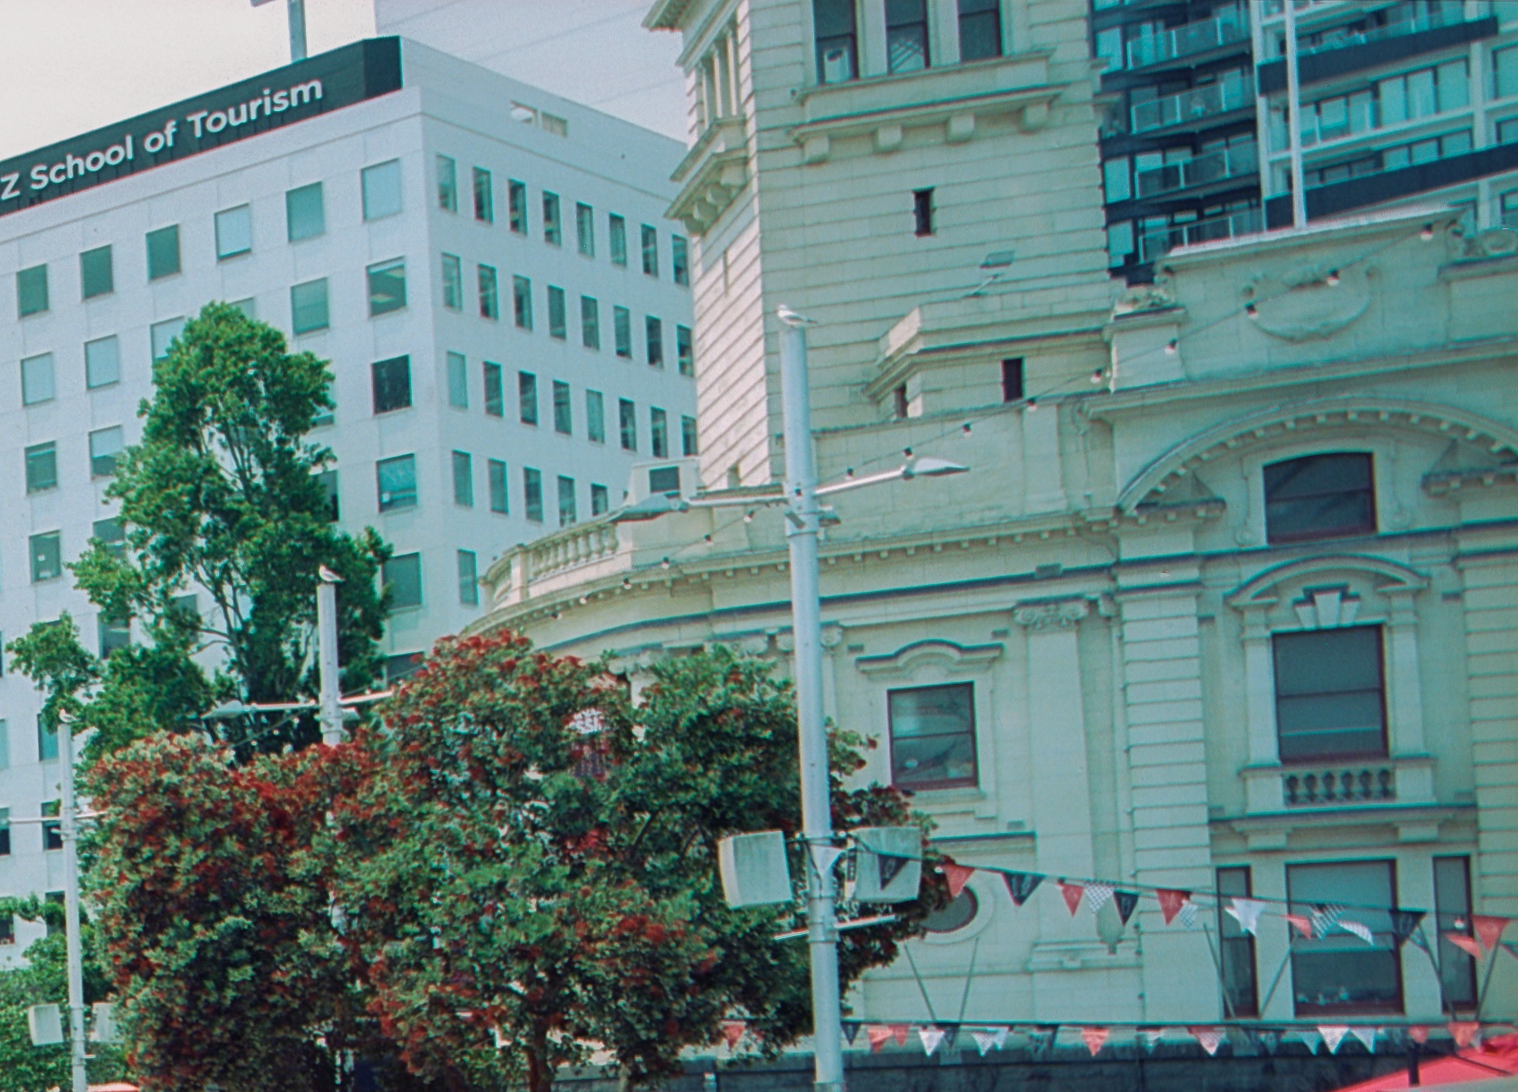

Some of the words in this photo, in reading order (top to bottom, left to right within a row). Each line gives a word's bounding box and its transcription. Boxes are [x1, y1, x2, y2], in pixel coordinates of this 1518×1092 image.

[29, 135, 134, 191] School
[143, 119, 178, 153] of
[186, 79, 323, 138] Tourism
